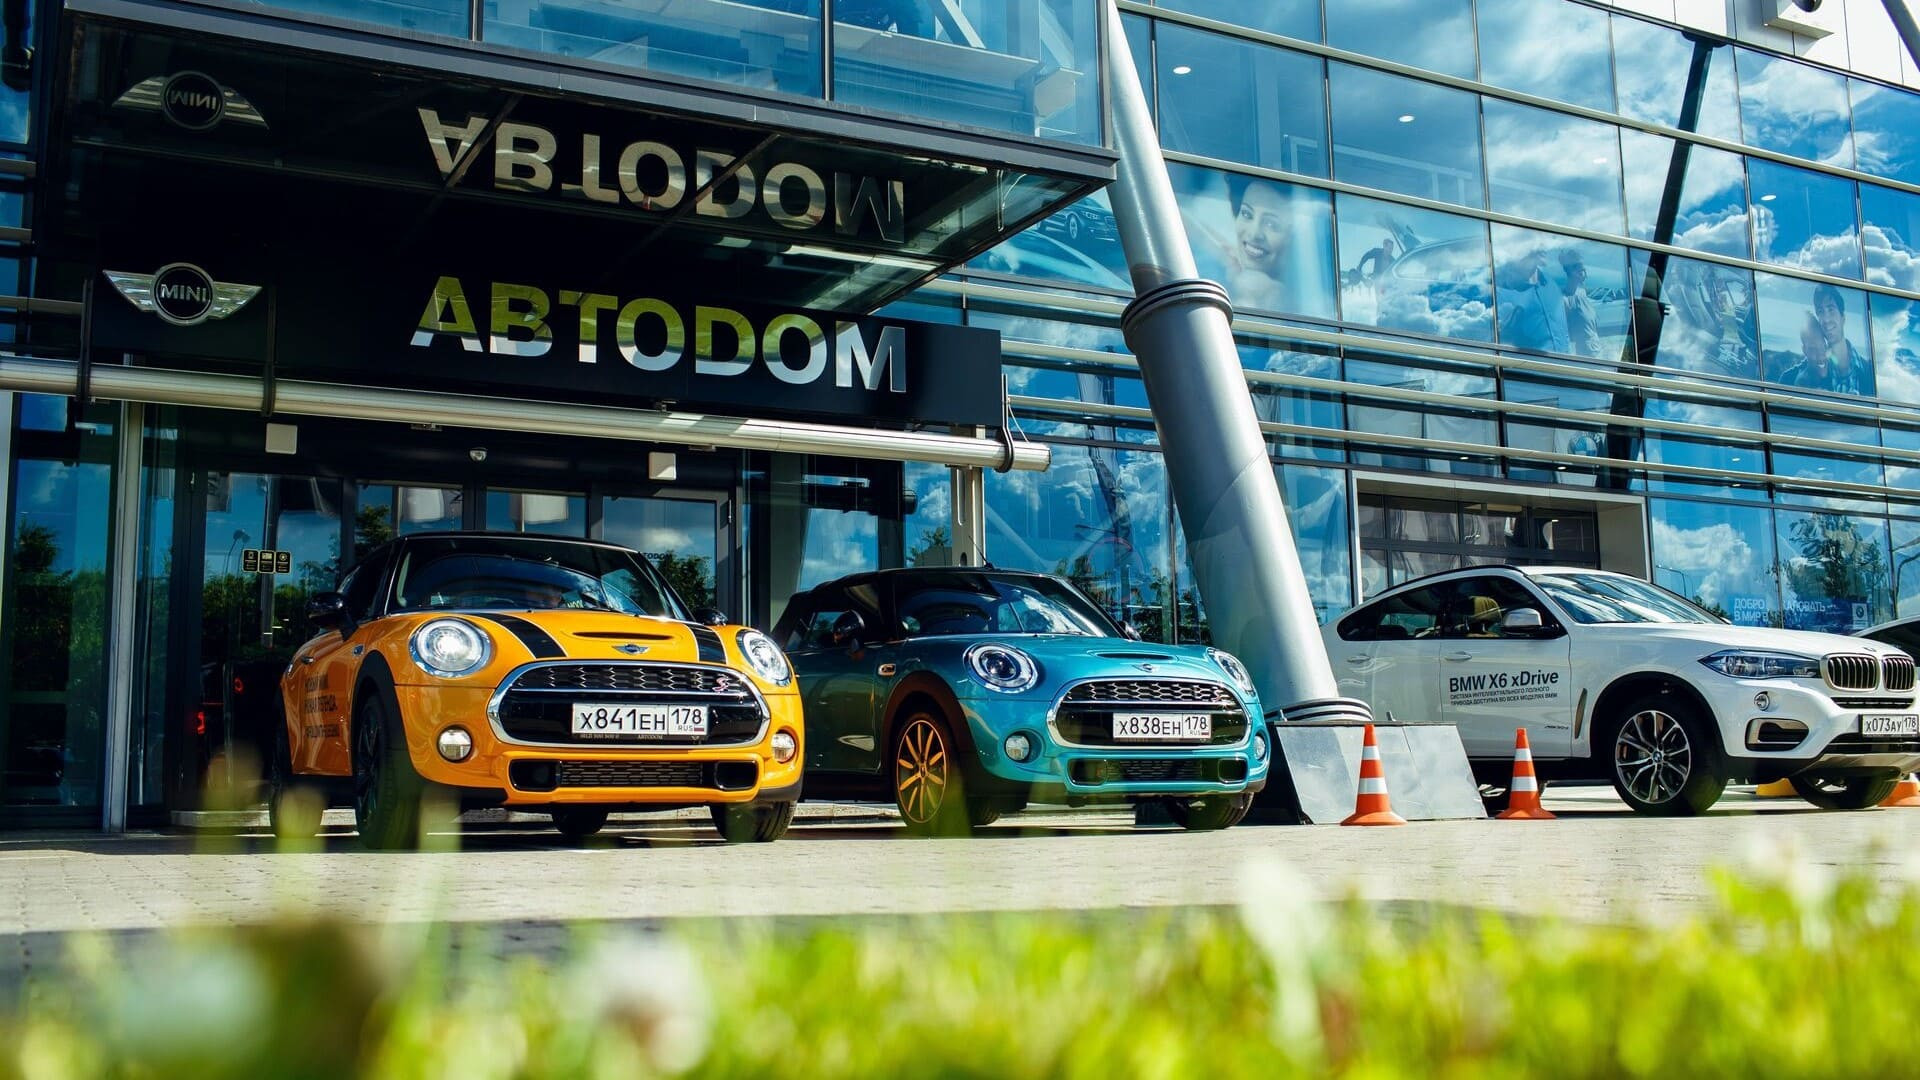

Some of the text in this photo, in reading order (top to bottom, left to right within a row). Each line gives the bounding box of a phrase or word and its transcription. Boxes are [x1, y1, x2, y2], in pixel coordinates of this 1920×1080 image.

[160, 283, 207, 302] MINI
[1734, 598, 1765, 610] ДОБРО
[1449, 669, 1559, 692] BMW X6 xDrive
[580, 708, 702, 731] Х841ЕН 178
[1119, 716, 1208, 735] Х838ЕН 178
[1904, 717, 1916, 728] 178
